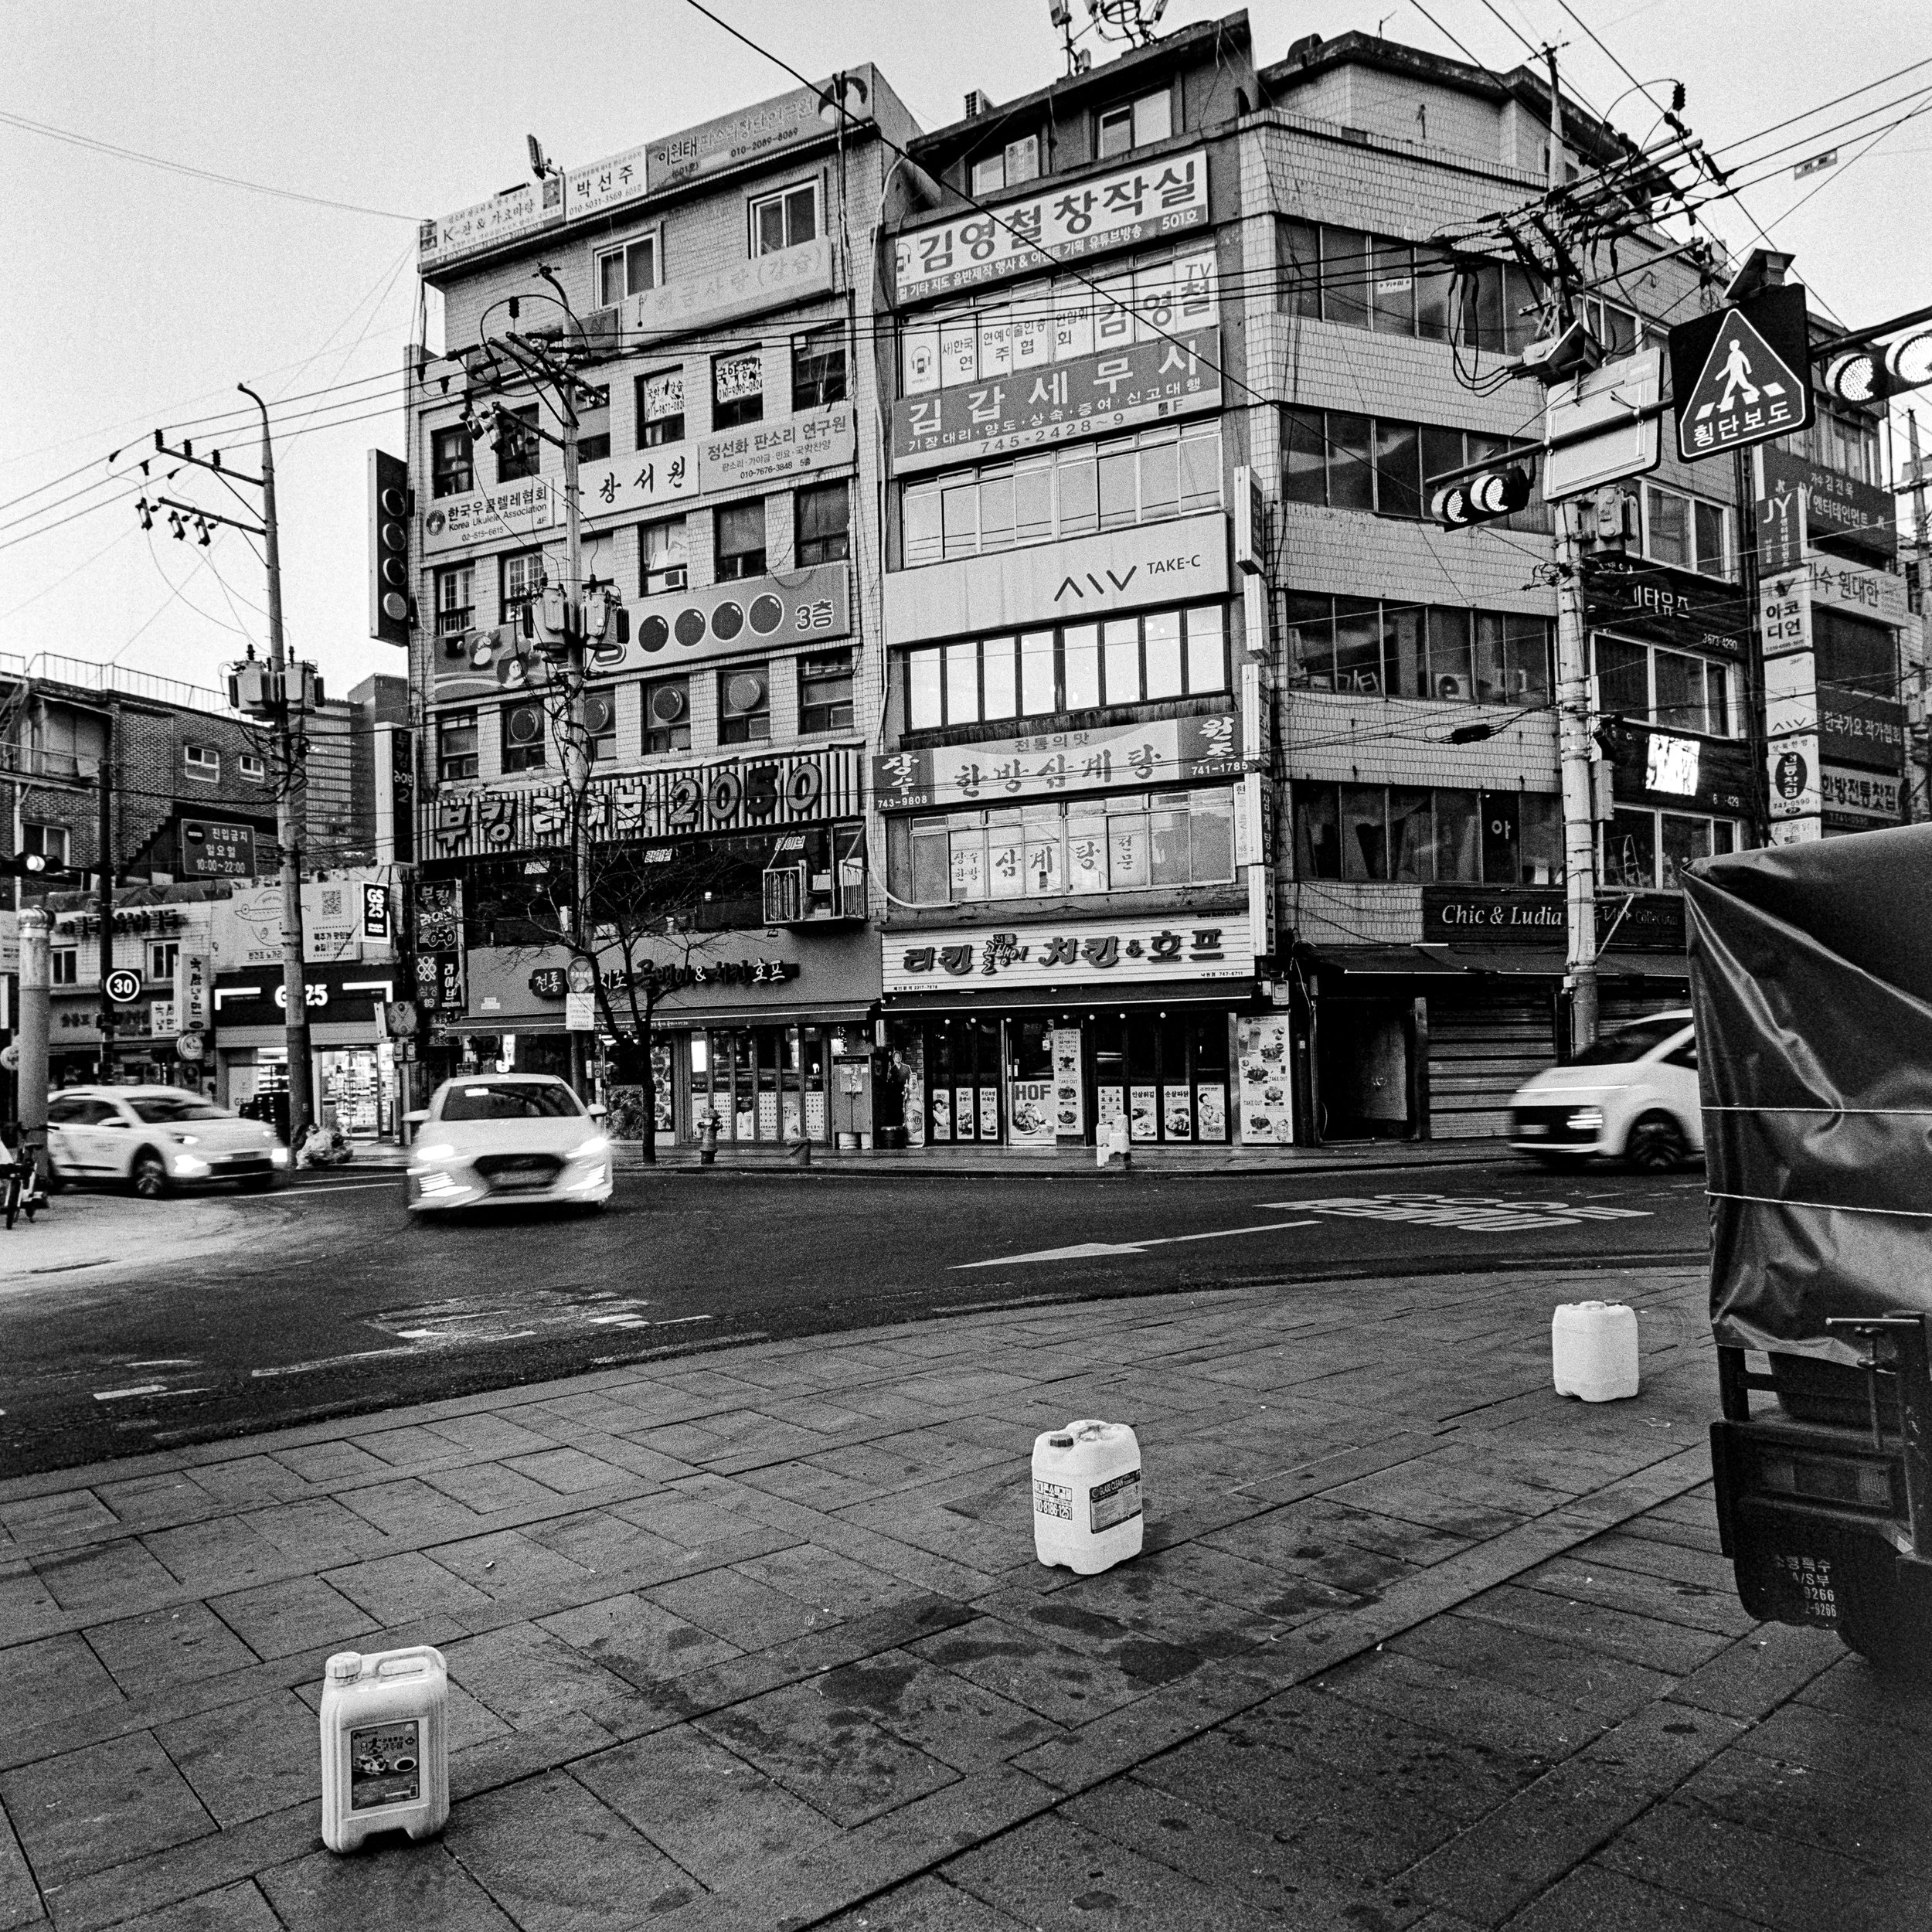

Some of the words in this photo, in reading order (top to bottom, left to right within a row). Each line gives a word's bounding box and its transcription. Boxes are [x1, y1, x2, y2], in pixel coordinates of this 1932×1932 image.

[657, 135, 698, 165] 이원태
[920, 203, 1043, 274] 김영철
[1053, 160, 1196, 234] 창작실
[910, 280, 930, 298] 기타
[932, 274, 951, 291] 지도
[953, 262, 993, 287] 음반제작
[995, 257, 1016, 276] 행사
[1018, 254, 1029, 268] &
[1031, 246, 1061, 265] 이벤트
[1063, 239, 1086, 257] 기획
[1088, 224, 1142, 250] 유튜브방송
[1161, 210, 1199, 232] 501호
[1184, 262, 1213, 281] TV
[1693, 400, 1791, 447] 횡단보도
[707, 437, 750, 462] 정선화
[753, 426, 796, 451] 판소리
[802, 415, 847, 440] 연구원
[579, 455, 686, 505] 창서원
[448, 517, 471, 532] Korea
[472, 513, 501, 528] Ukulele
[502, 502, 547, 522] Association
[536, 515, 547, 526] 4F
[1763, 492, 1793, 524] JY
[1145, 553, 1202, 576] TAKE-C
[795, 598, 834, 632] 3층
[1767, 617, 1801, 640] 디언
[953, 743, 1162, 798] 한방삼계탕
[1191, 760, 1250, 777] 741-1785
[876, 794, 928, 809] 743-9808
[211, 827, 249, 844] 진입금지
[436, 798, 518, 852] 부킹
[205, 843, 236, 859] 일요일
[196, 858, 247, 874] 10:00~22:00
[366, 888, 385, 903] GS
[367, 903, 384, 919] 25
[1441, 904, 1485, 925] Chic
[1489, 905, 1505, 925] &
[1510, 905, 1563, 926] Ludia
[903, 942, 975, 975] 리킨
[1037, 935, 1120, 969] 치킨
[1124, 939, 1145, 958] &
[1146, 927, 1225, 963] 호프
[113, 978, 133, 994] 30
[534, 971, 562, 993] 전통
[695, 965, 707, 982] &
[751, 957, 786, 983] 호프
[274, 983, 328, 1008] G25
[1015, 1083, 1052, 1100] HOF
